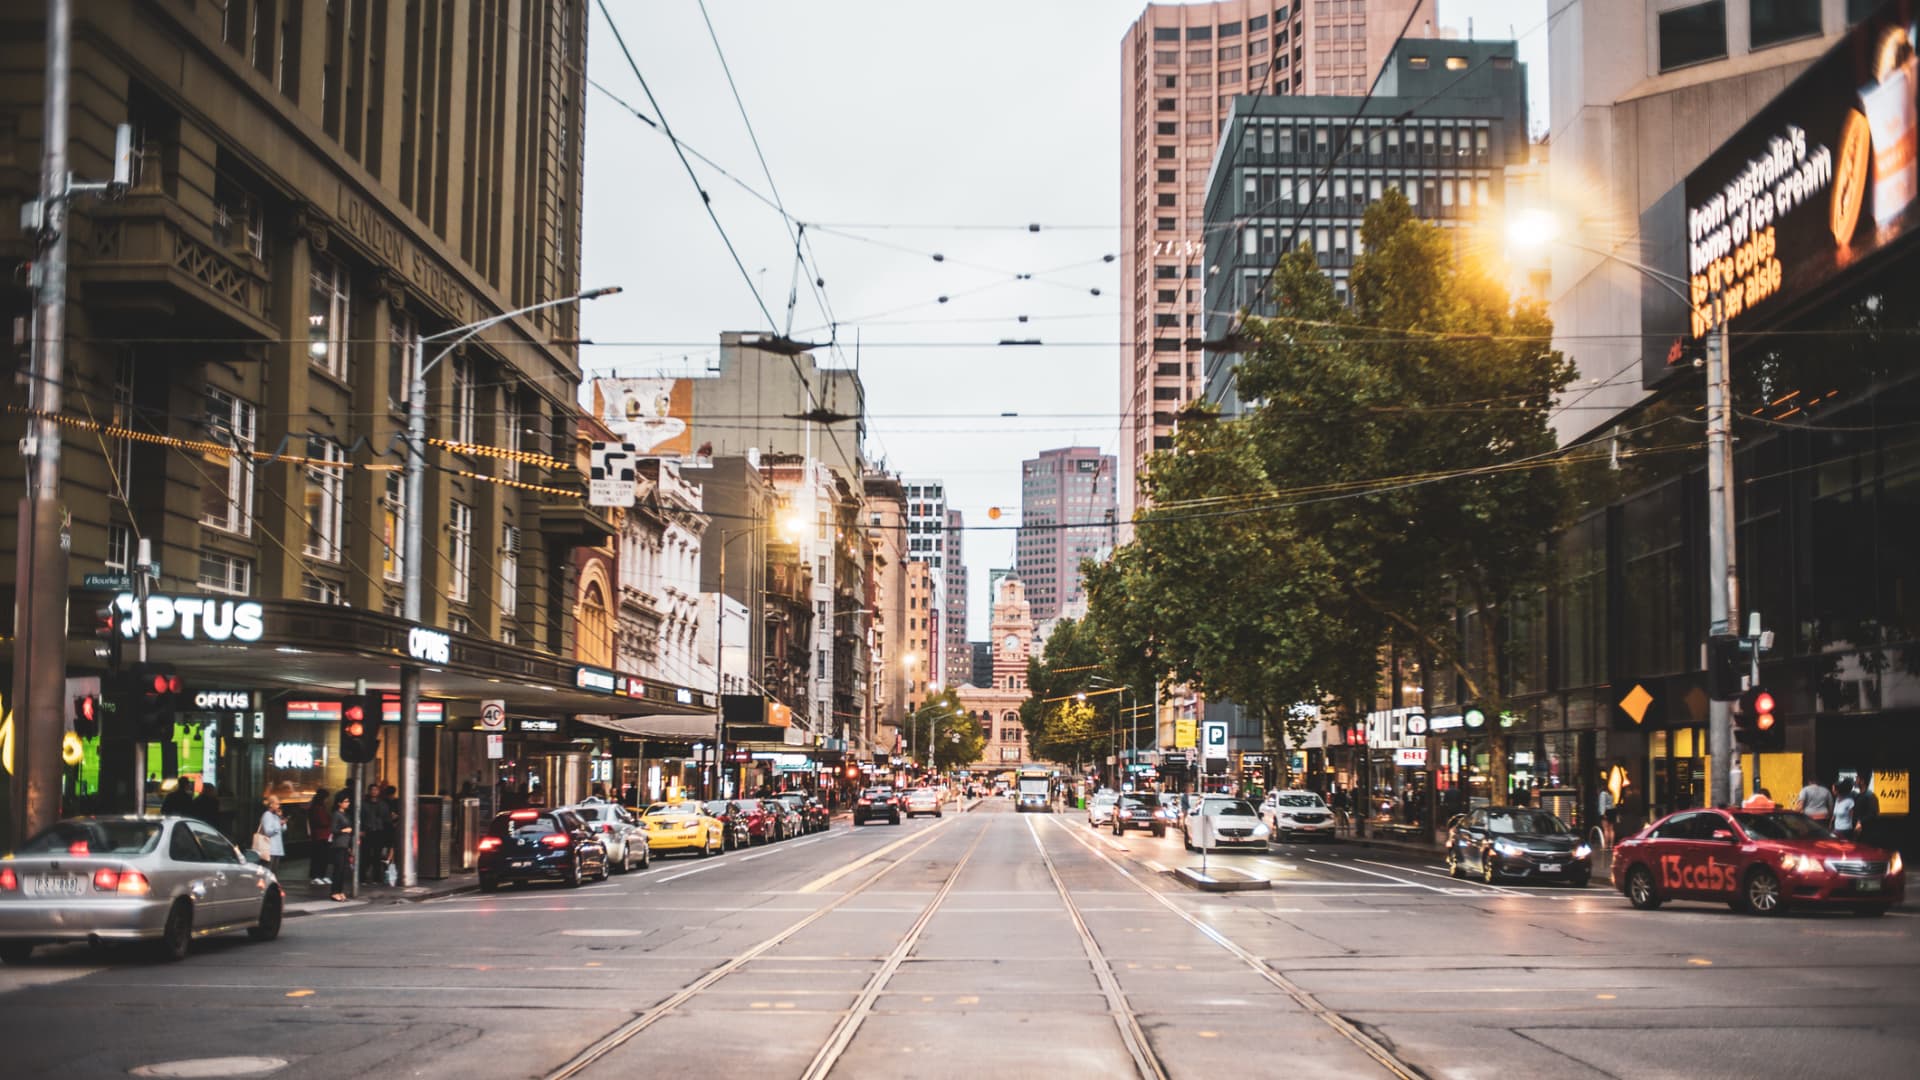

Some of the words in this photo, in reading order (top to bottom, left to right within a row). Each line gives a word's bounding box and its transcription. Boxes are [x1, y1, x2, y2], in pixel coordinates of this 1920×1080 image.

[1689, 194, 1725, 242] from
[1726, 124, 1806, 211] australia's
[1690, 224, 1731, 274] home
[1732, 202, 1750, 246] of
[1750, 191, 1773, 232] ice
[1776, 144, 1832, 217] cream
[337, 184, 404, 273] LONDON
[413, 252, 464, 319] STORES
[1691, 273, 1708, 304] to
[1735, 225, 1776, 278] coles
[1745, 257, 1782, 309] aisle
[92, 576, 119, 585] Bourke
[120, 577, 130, 585] St
[408, 627, 450, 664] OPTUS
[195, 692, 249, 709] OPTUS
[485, 709, 501, 721] 40
[1211, 727, 1223, 743] P
[274, 743, 313, 769] OPTUS
[1661, 855, 1736, 891] 13cabs
